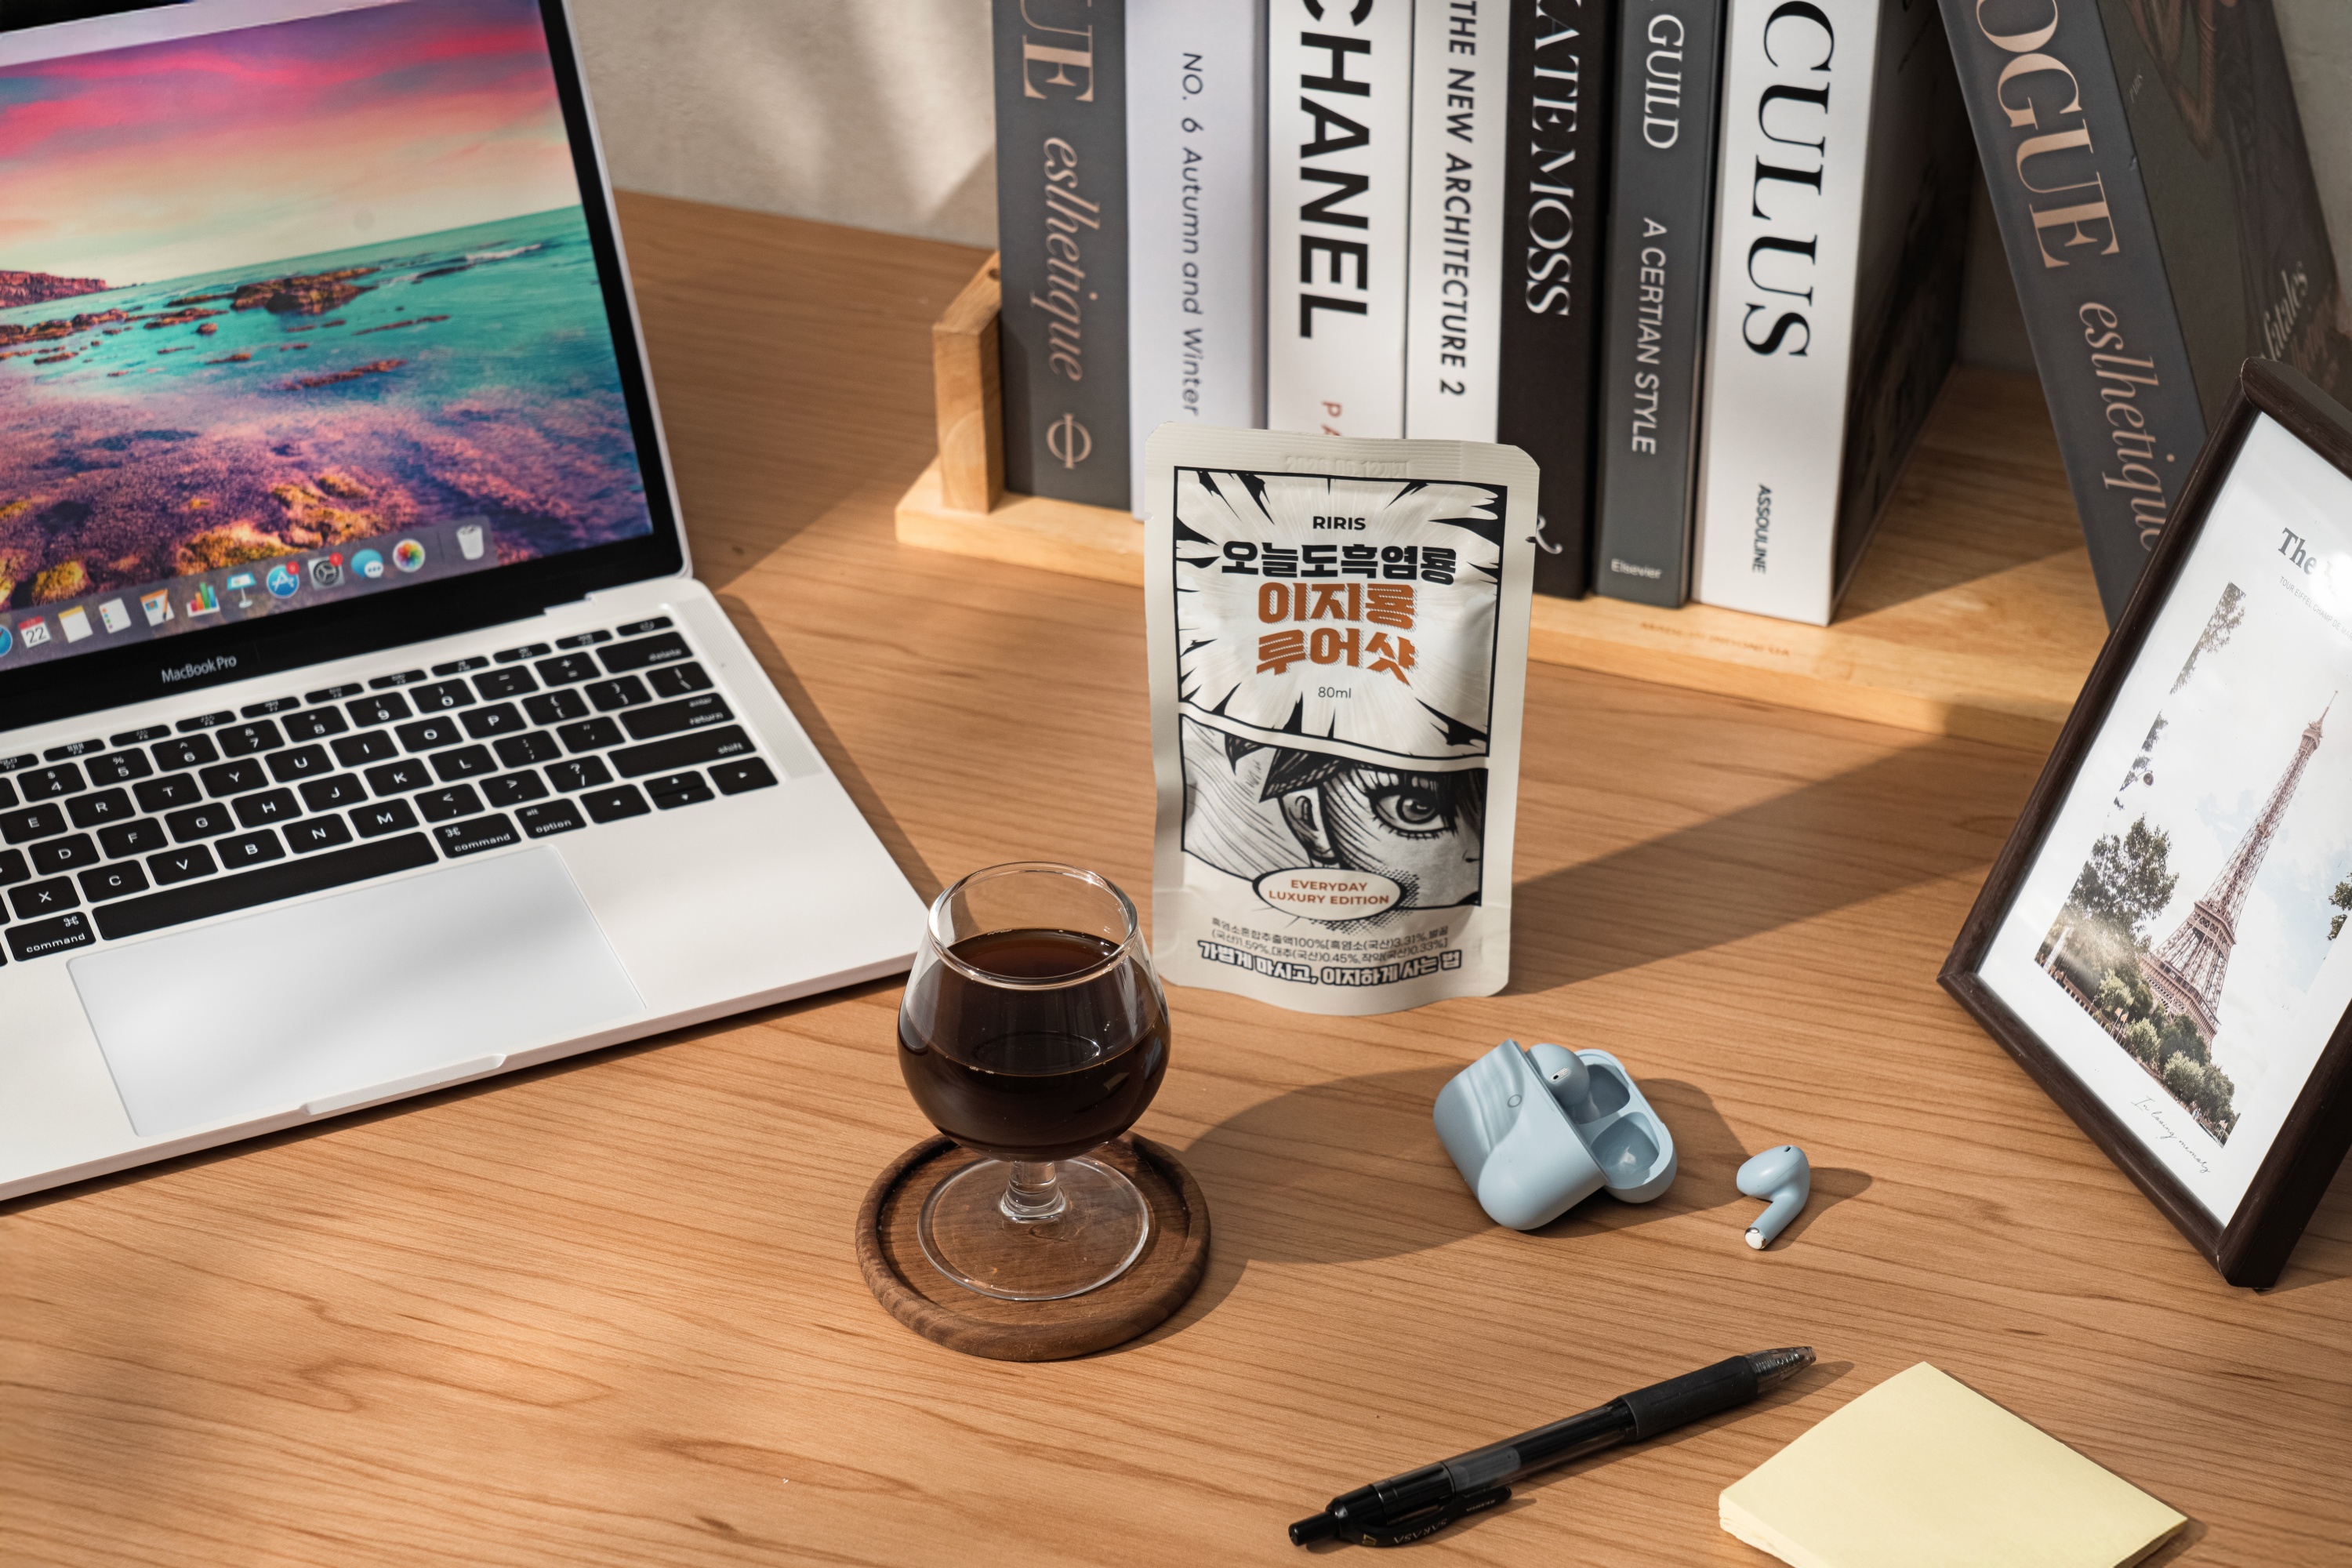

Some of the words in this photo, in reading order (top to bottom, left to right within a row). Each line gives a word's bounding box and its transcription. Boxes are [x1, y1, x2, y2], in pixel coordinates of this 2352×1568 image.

[1450, 0, 1477, 56] THE
[1181, 52, 1203, 101] NO.
[1643, 13, 1686, 150] GUILD
[1446, 67, 1475, 144] NEW
[1181, 116, 1204, 134] 6
[1741, 0, 1835, 358] CULUS
[1181, 146, 1203, 255] Autumn
[1642, 217, 1668, 238] A
[1439, 152, 1474, 368] ARCHITECTURE
[1181, 262, 1204, 314] and
[1635, 247, 1667, 365] CERTIAN
[1181, 327, 1203, 418] Winter
[1439, 378, 1466, 395] 2
[1631, 371, 1661, 456] STYLE
[1312, 515, 1367, 531] RIRIS
[1752, 483, 1773, 575] ASSOULINE
[2278, 527, 2318, 575] The
[1221, 540, 1457, 586] 오늘도흑염룡
[1610, 557, 1663, 580] Elsevier
[2279, 575, 2296, 593] TOUR
[2294, 587, 2313, 608] EIFFEL
[2313, 603, 2333, 622] CHAMP
[2332, 619, 2343, 631] DE
[26, 626, 46, 644] 22
[162, 657, 217, 684] MacBook
[216, 655, 237, 671] Pro
[1318, 687, 1352, 699] 80ml
[378, 710, 389, 720] 9
[488, 716, 499, 725] P
[314, 724, 325, 734] 8
[251, 738, 258, 747] 7
[184, 753, 195, 761] 6
[295, 757, 307, 768] U
[459, 760, 471, 768] L
[118, 768, 129, 776] 5
[230, 772, 239, 782] Y
[394, 773, 407, 783] K
[52, 782, 62, 790] 4
[163, 787, 172, 797] T
[332, 787, 339, 797] J
[96, 803, 107, 812] R
[263, 802, 276, 813] H
[28, 818, 39, 828] E
[196, 818, 208, 827] G
[377, 813, 393, 824] M
[535, 818, 572, 833] option
[129, 833, 137, 843] F
[312, 828, 326, 839] N
[245, 844, 258, 855] B
[454, 833, 510, 853] command
[59, 849, 71, 859] D
[176, 859, 187, 869] V
[109, 876, 121, 885] C
[1290, 879, 1368, 892] EVERYDAY
[39, 891, 52, 902] X
[1268, 889, 1326, 904] LUXURY
[1330, 895, 1390, 906] EDITION
[26, 932, 85, 953] command
[1320, 964, 1400, 987] 이지하게
[1439, 949, 1463, 971] 법
